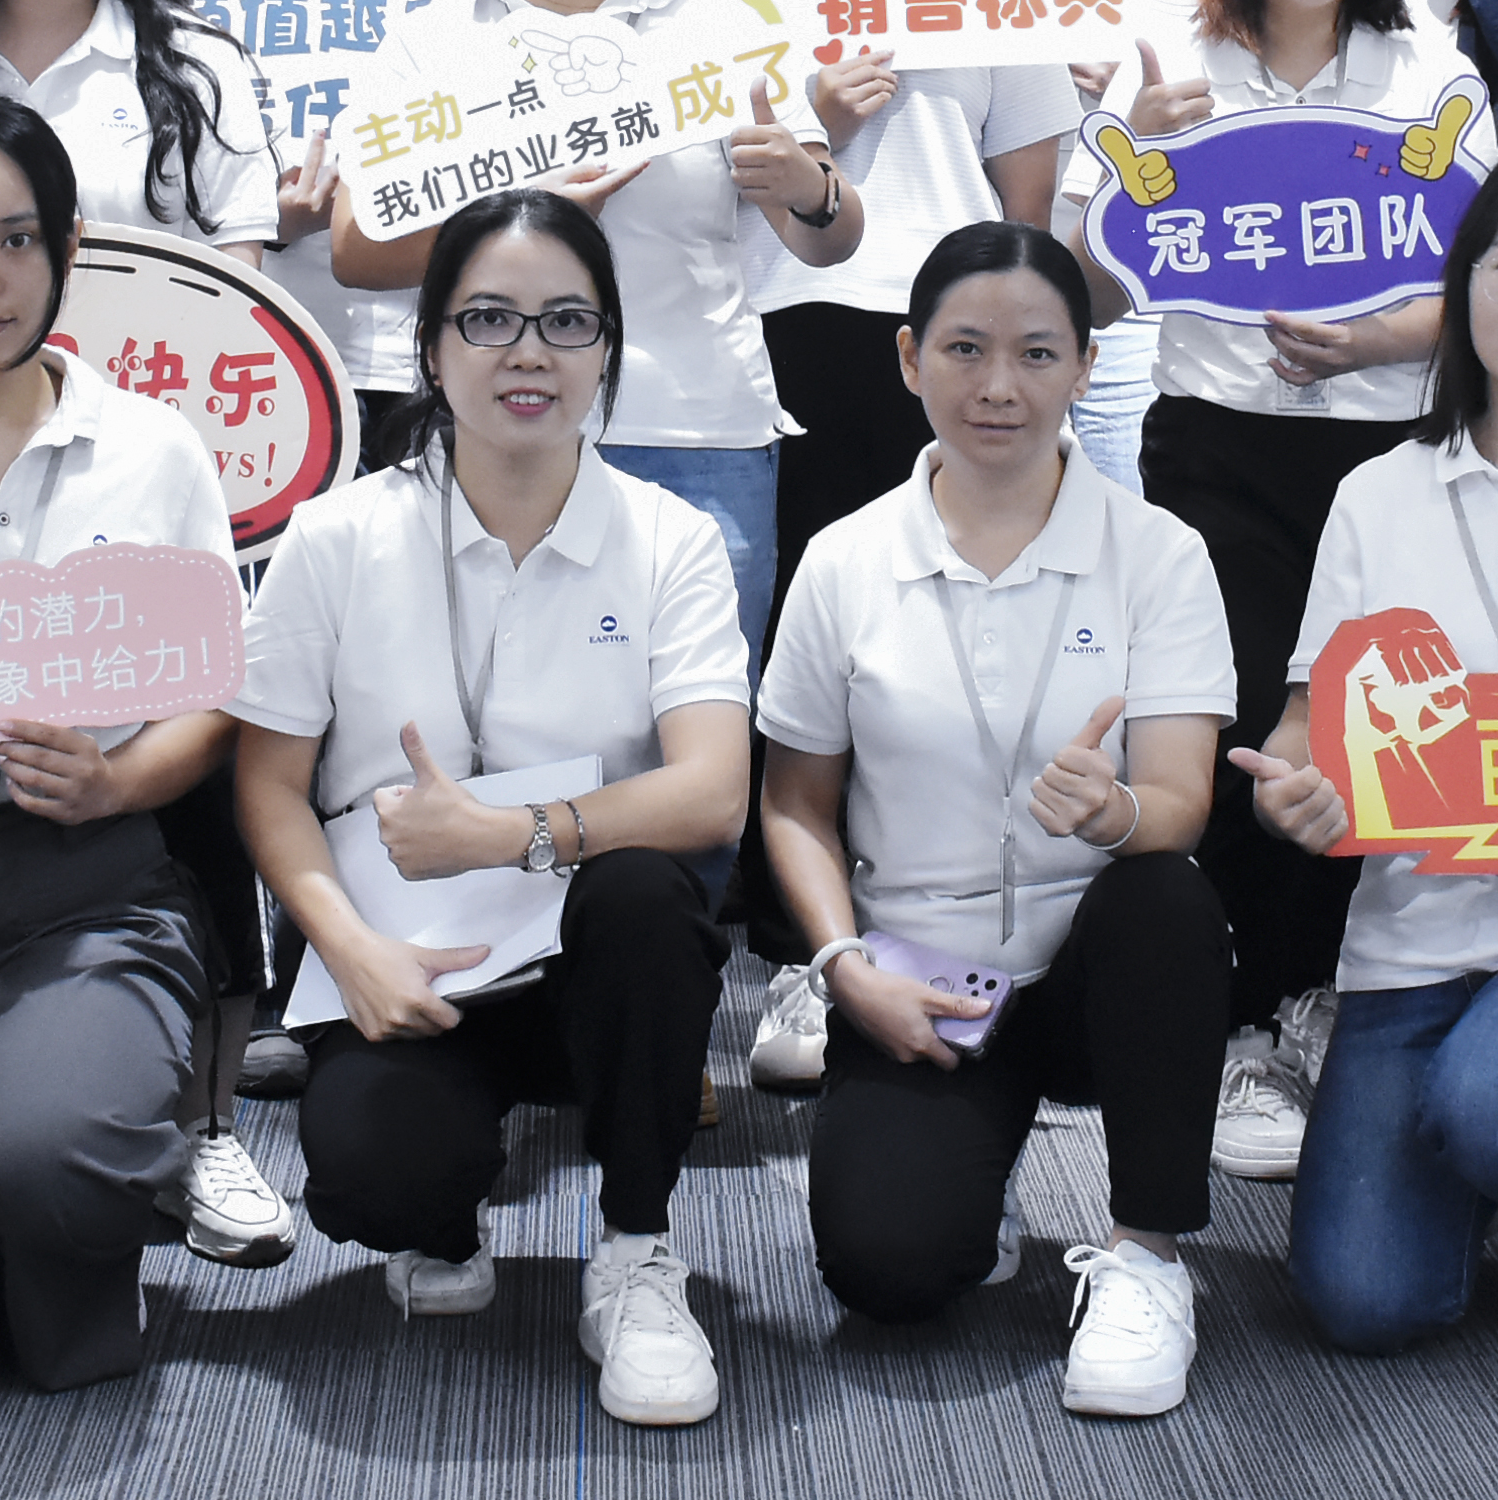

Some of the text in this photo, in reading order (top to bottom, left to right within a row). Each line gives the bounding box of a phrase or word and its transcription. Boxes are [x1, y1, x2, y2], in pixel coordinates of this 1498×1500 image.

[354, 78, 547, 168] 主动一点
[1145, 193, 1444, 277] 冠军团队
[46, 333, 277, 427] 快乐
[588, 634, 630, 645] EASTON
[1063, 646, 1106, 654] EASTON
